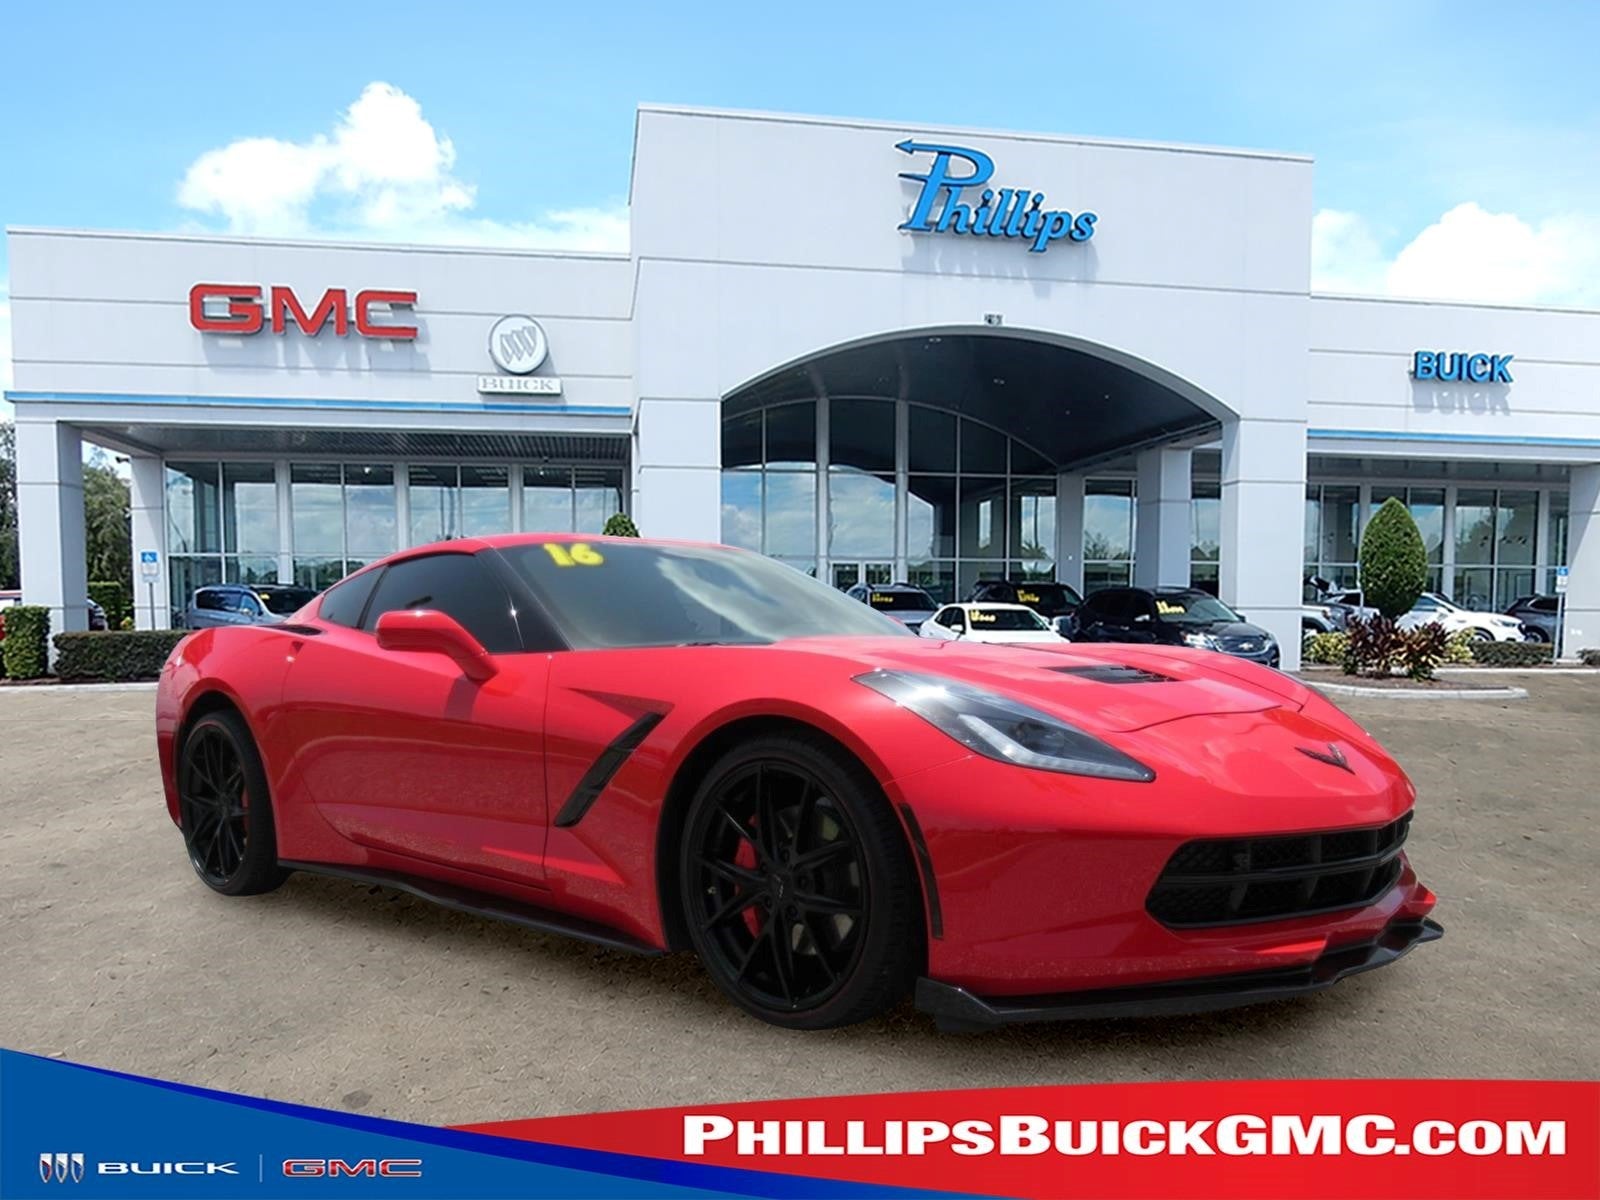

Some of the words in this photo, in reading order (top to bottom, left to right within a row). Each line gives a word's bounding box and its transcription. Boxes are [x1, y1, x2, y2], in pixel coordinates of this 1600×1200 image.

[895, 139, 1098, 253] Phillips
[189, 282, 418, 341] GMC
[1414, 350, 1514, 383] BUICK
[482, 377, 553, 391] BUICK
[544, 543, 603, 566] 16
